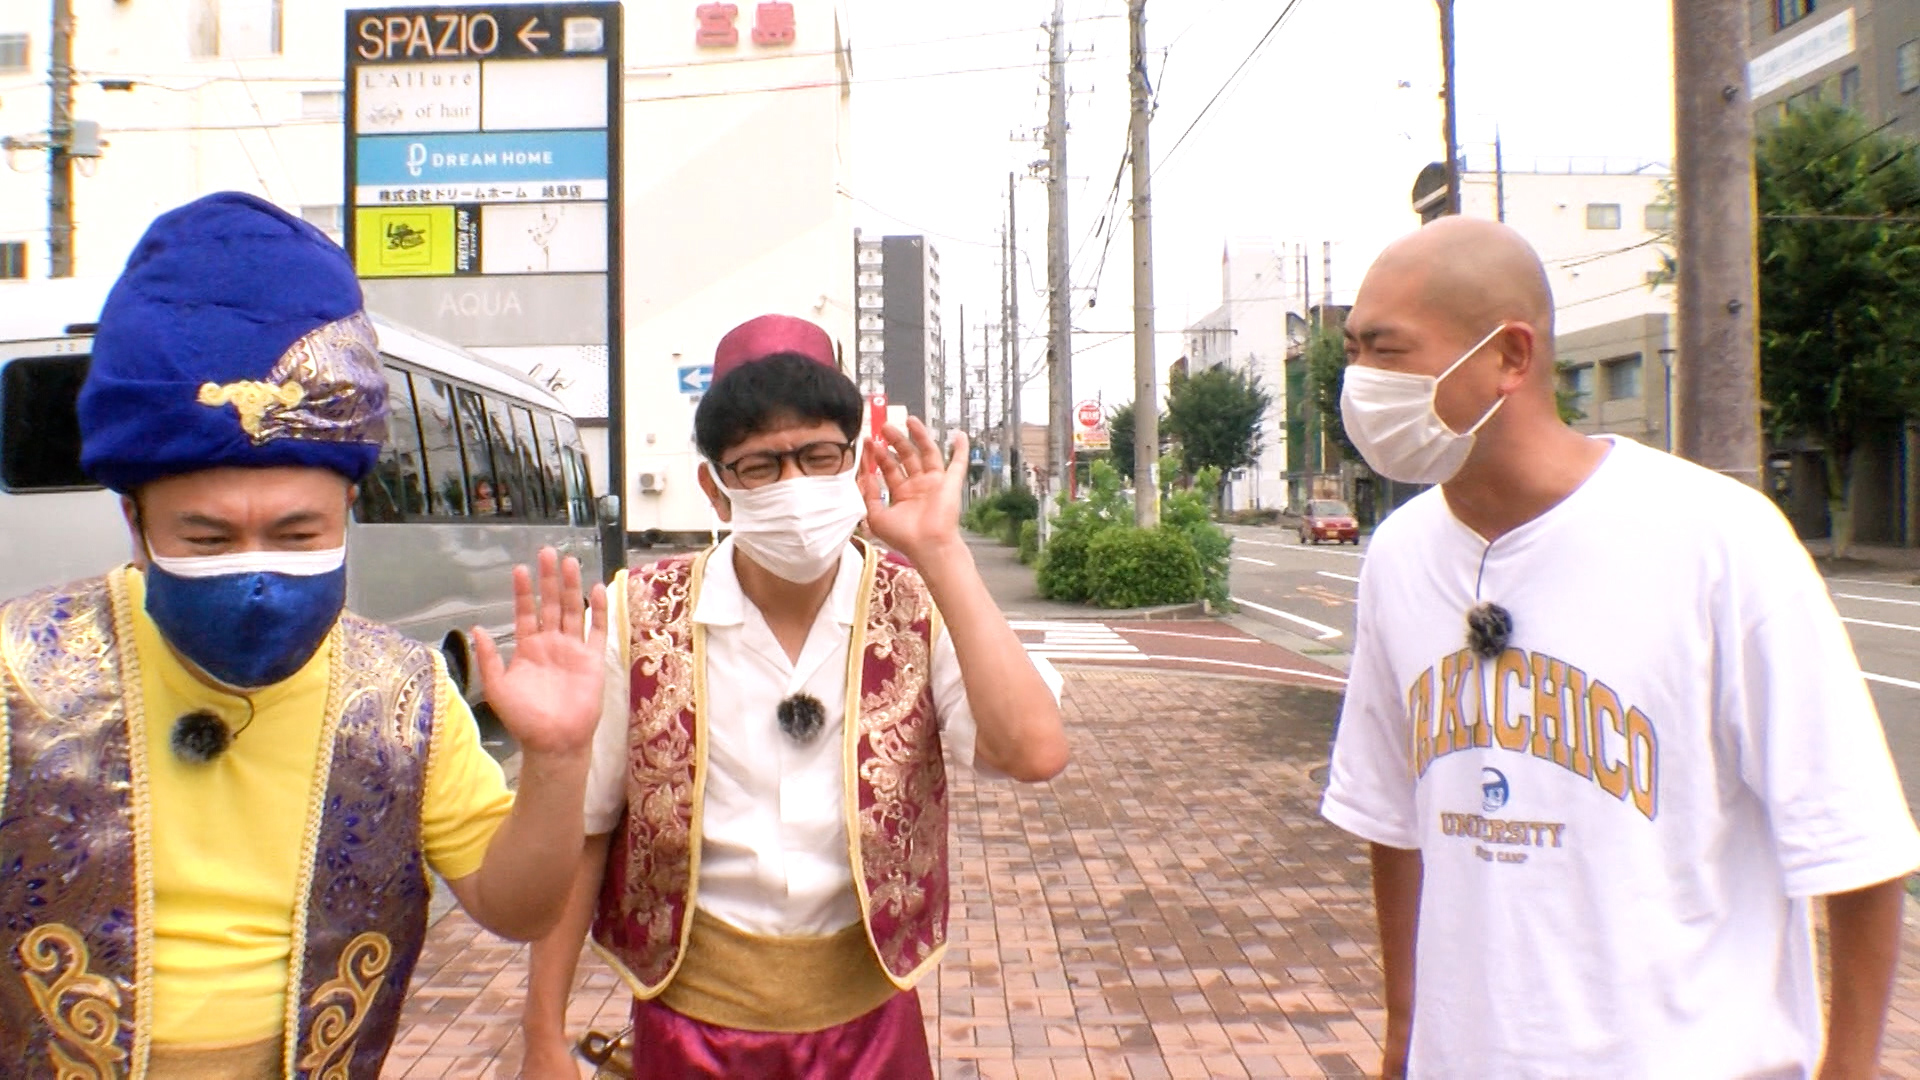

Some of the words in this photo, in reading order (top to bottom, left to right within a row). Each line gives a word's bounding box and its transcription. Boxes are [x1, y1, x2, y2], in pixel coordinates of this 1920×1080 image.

[358, 13, 498, 60] SPAZIO
[415, 103, 432, 118] of
[440, 103, 472, 118] hair
[433, 151, 497, 167] DREAM
[502, 151, 553, 166] HOME
[439, 292, 522, 317] AQUA
